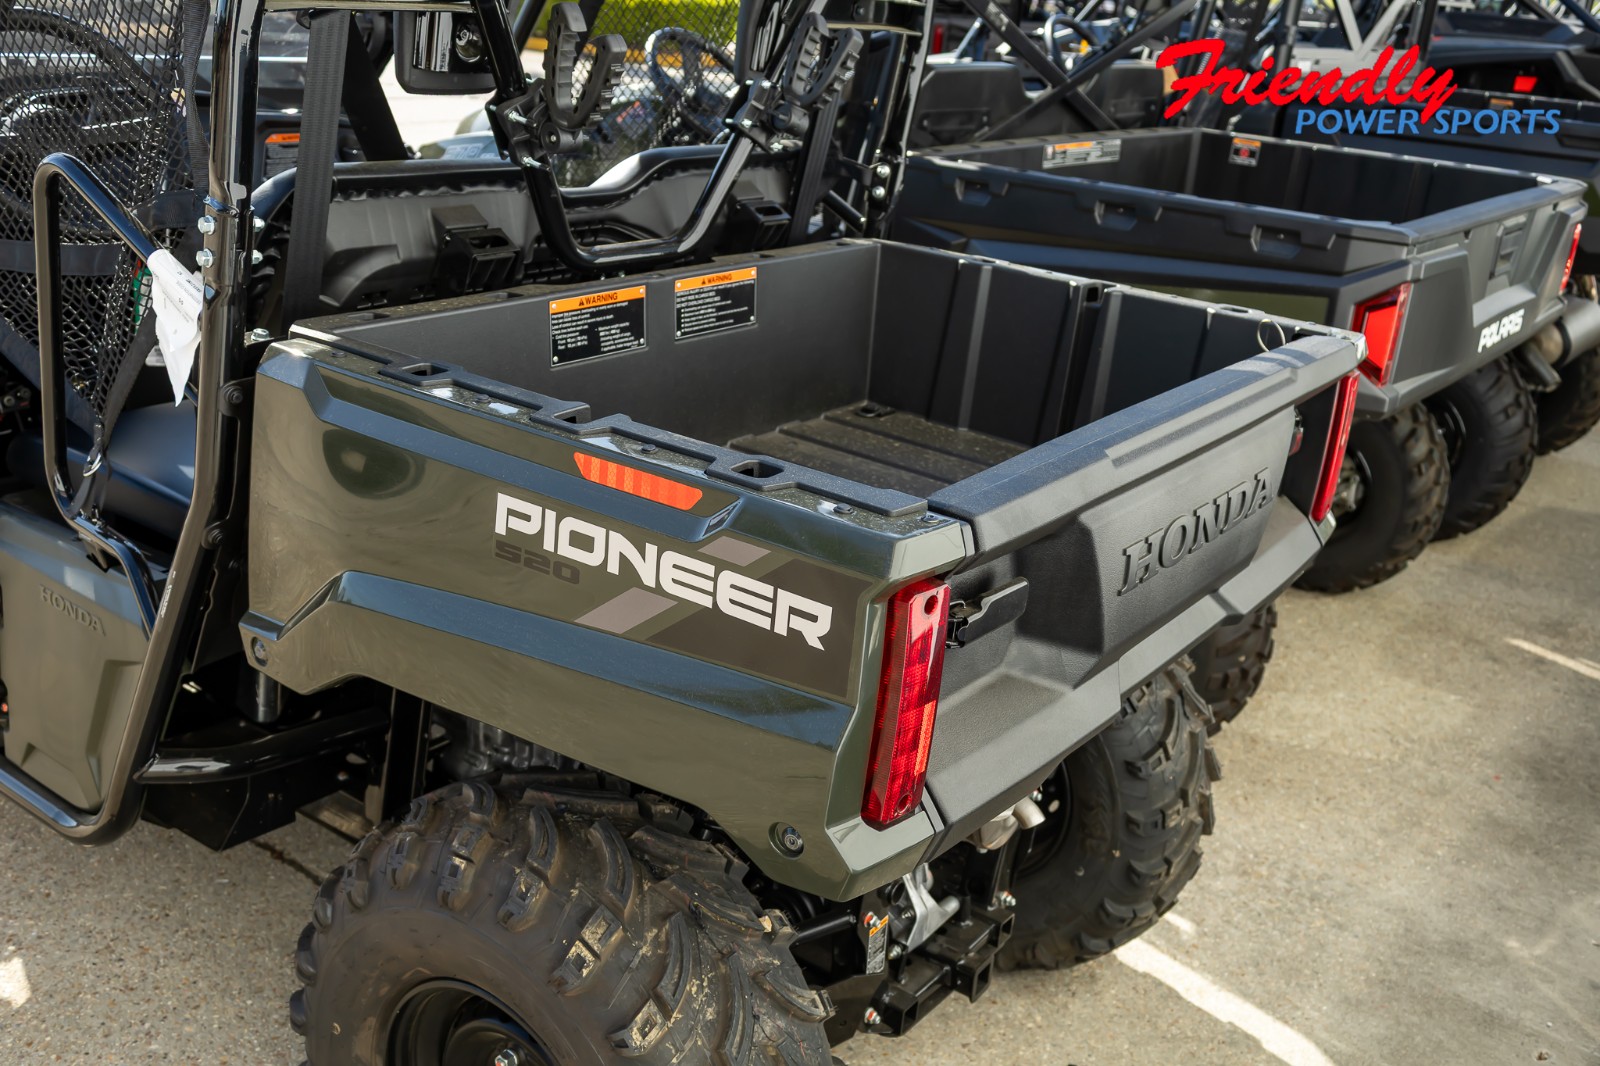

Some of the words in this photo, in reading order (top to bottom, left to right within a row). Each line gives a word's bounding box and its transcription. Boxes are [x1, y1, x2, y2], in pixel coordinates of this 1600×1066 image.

[585, 292, 618, 306] WARNING
[707, 273, 733, 285] WARNING
[1478, 308, 1525, 353] POLARIS
[1116, 467, 1274, 596] HONDA
[494, 540, 580, 585] 520
[494, 492, 833, 651] PIONEER
[39, 583, 107, 637] HONDA
